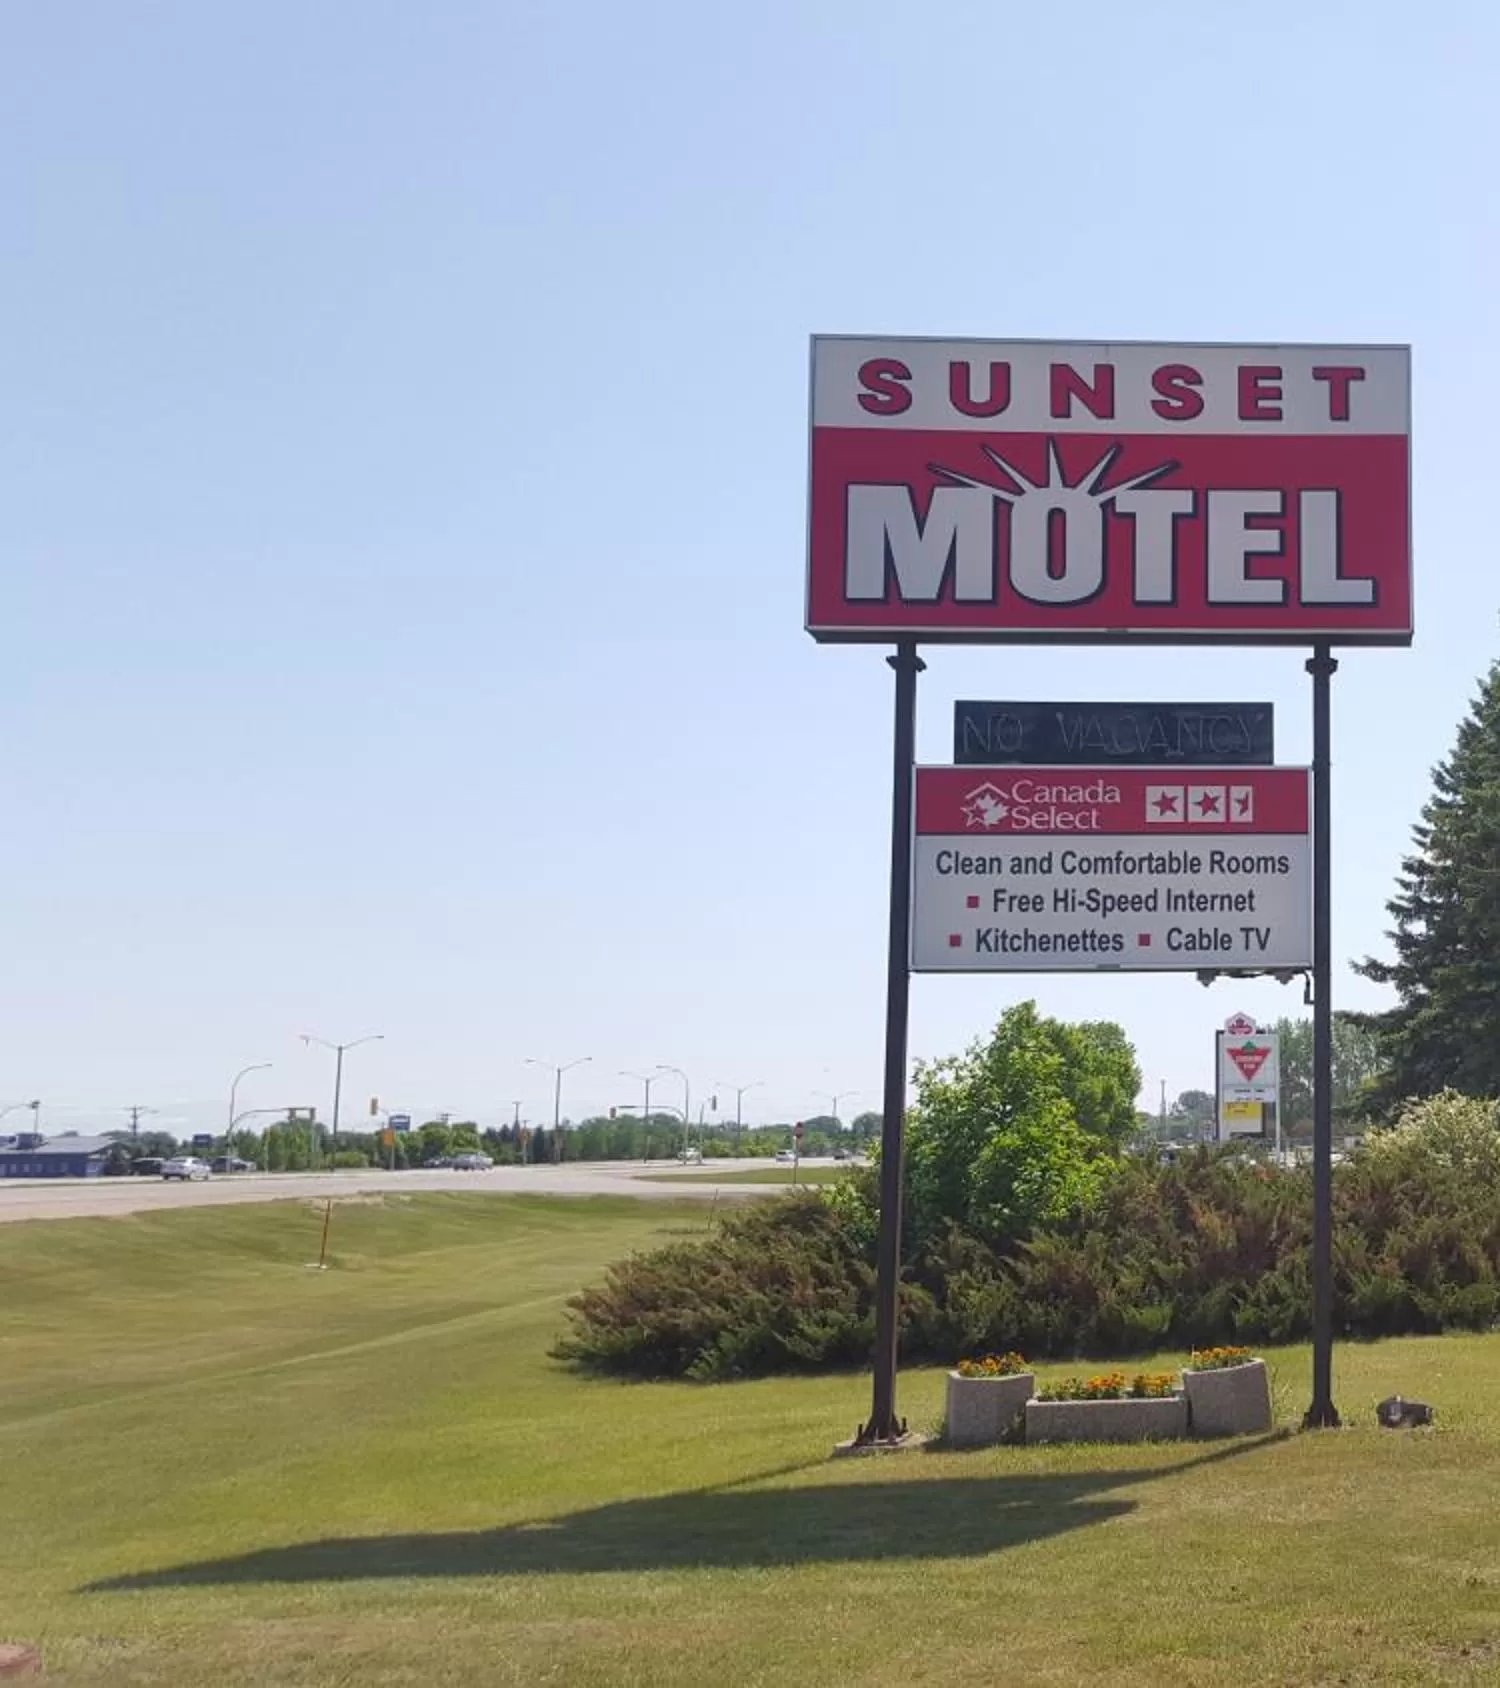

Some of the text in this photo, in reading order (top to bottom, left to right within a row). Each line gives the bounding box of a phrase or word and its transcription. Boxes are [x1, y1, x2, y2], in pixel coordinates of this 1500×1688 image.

[857, 358, 1366, 421] SUNSET
[844, 483, 1378, 605] MOTEL
[962, 712, 1264, 757] NO VACANCY
[1011, 779, 1121, 804] Canada
[1011, 806, 1101, 830] Select
[935, 850, 1290, 875] Clean and Comfortable Rooms
[992, 888, 1256, 918] Free Hi-Speed Internet
[975, 927, 1271, 953] Kitchenettes Cable TV
